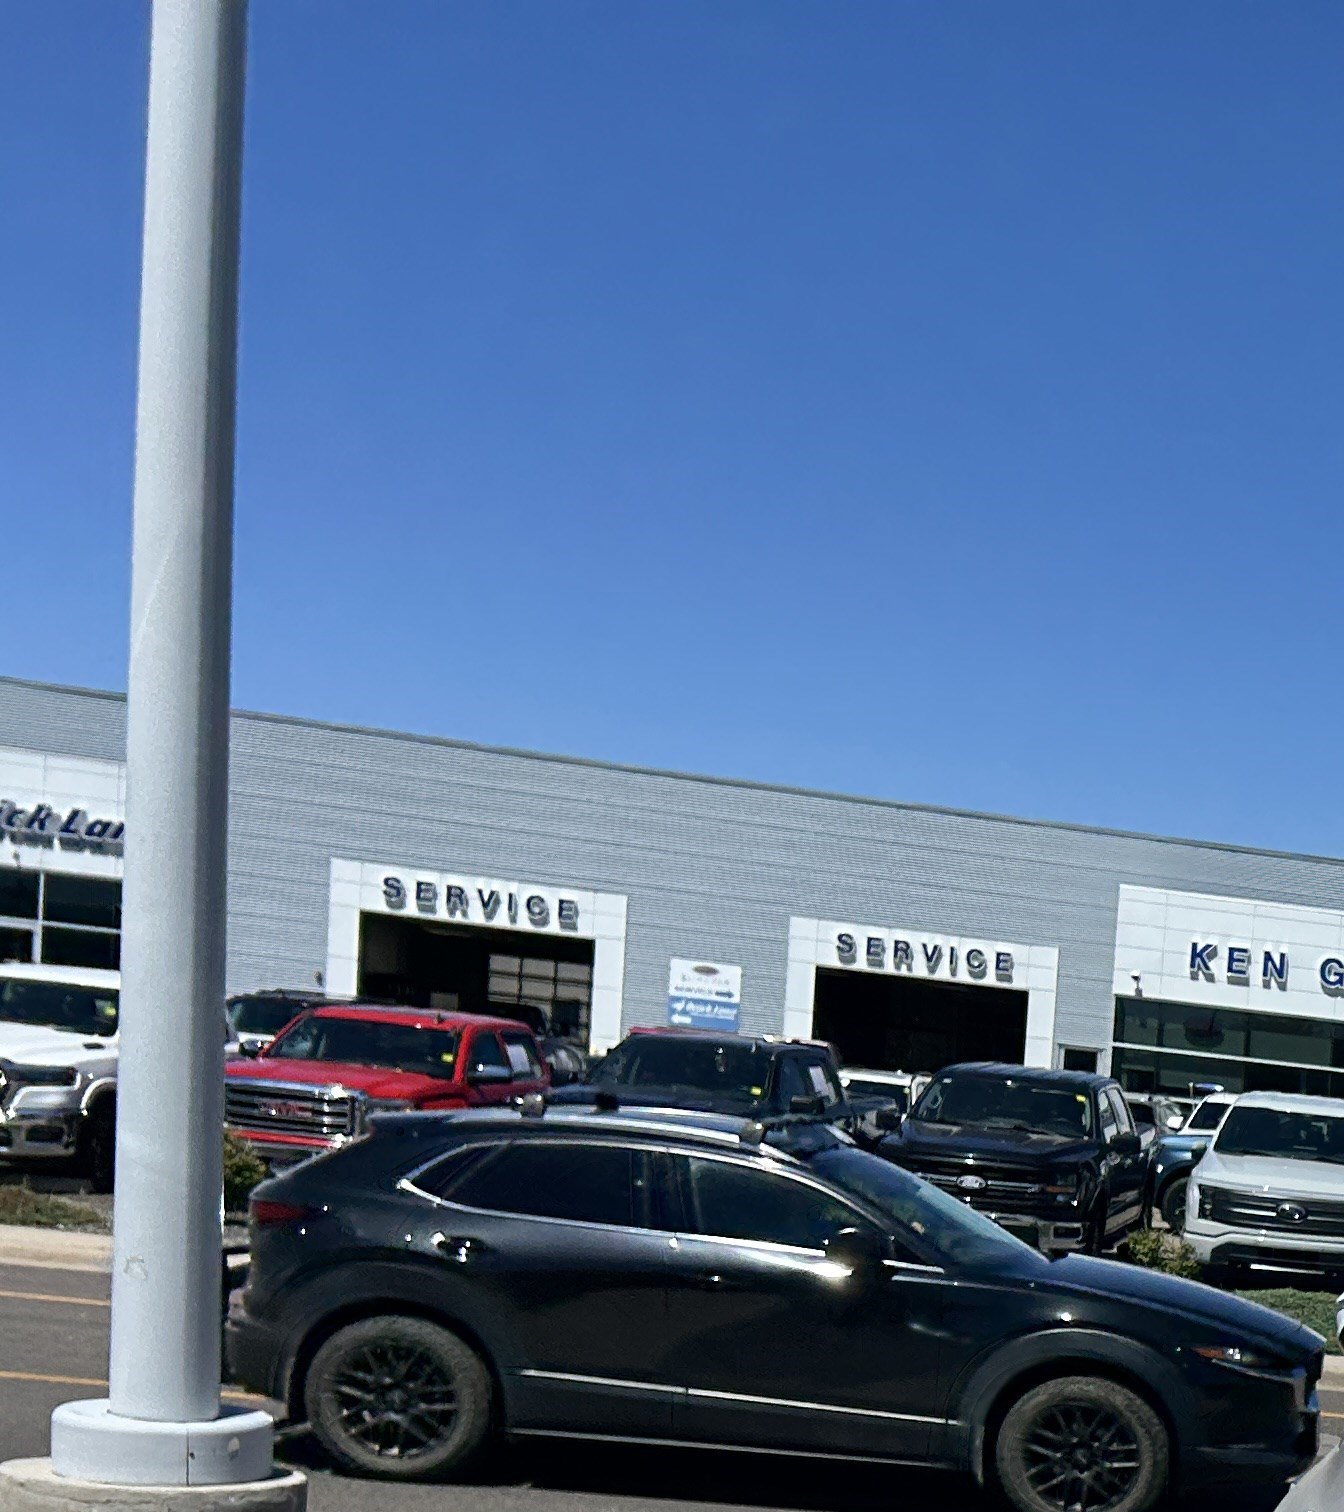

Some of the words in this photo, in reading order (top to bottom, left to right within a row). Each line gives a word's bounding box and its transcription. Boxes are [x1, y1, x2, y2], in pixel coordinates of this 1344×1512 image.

[382, 876, 578, 925] SERVICE
[836, 933, 1013, 973] SERVICE
[1189, 942, 1288, 980] KEN
